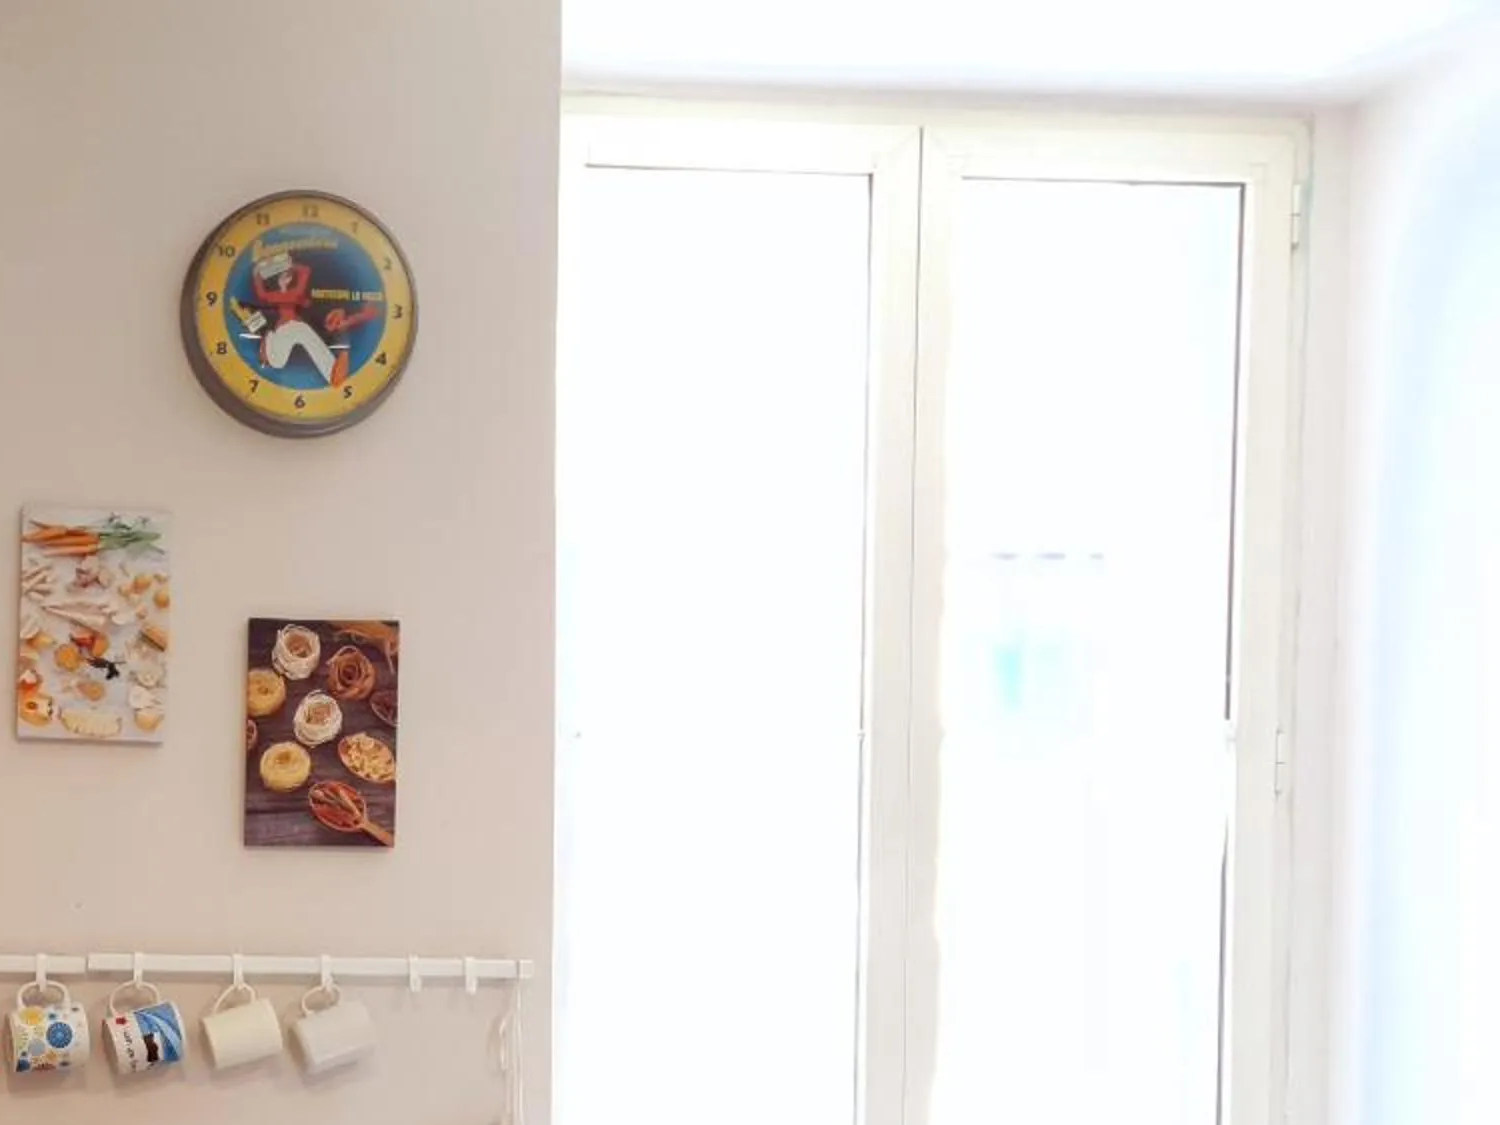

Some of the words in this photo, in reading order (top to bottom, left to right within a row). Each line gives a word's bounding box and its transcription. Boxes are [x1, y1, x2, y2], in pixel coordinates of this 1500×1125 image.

[206, 292, 217, 306] 9
[216, 342, 227, 355] 8
[249, 379, 259, 393] 7
[343, 385, 353, 399] 5
[294, 395, 305, 409] 6
